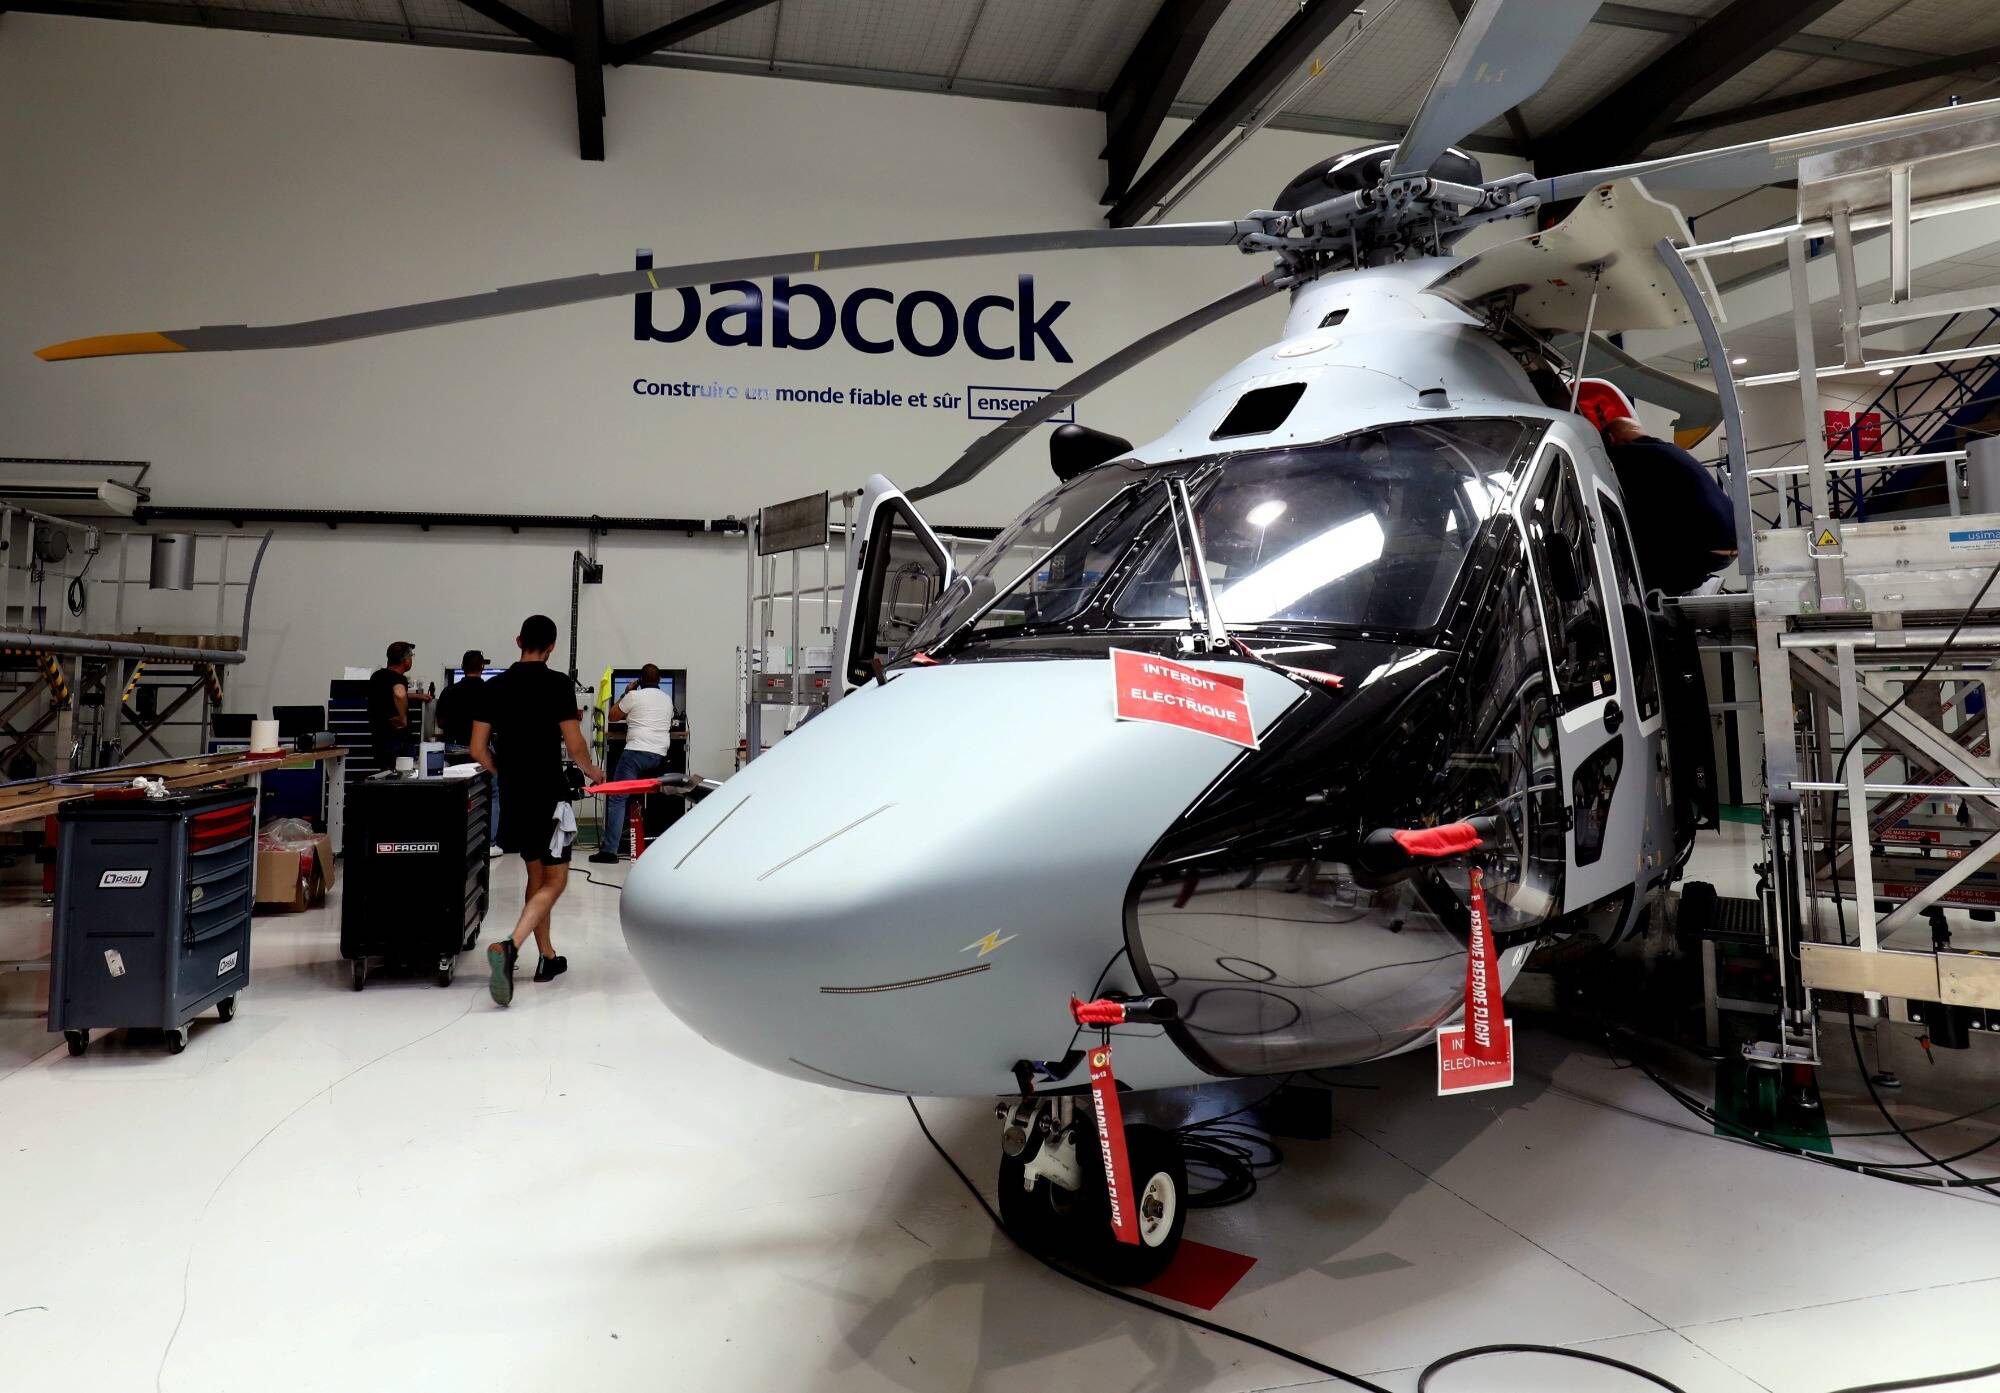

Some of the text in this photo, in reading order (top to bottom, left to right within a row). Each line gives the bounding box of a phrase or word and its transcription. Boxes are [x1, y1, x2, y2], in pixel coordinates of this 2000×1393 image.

[634, 248, 1073, 363] babcock
[775, 387, 844, 404] monde
[849, 388, 902, 406] fiable
[908, 392, 927, 408] et
[933, 392, 961, 409] sûr
[977, 396, 1064, 413] ensem
[1143, 662, 1217, 692] INTERDIT
[1131, 687, 1238, 722] ELECTRIQUE
[1470, 910, 1484, 956] REMOVE
[1471, 959, 1487, 1005] BEFORE
[1473, 1006, 1490, 1048] FLIGHT
